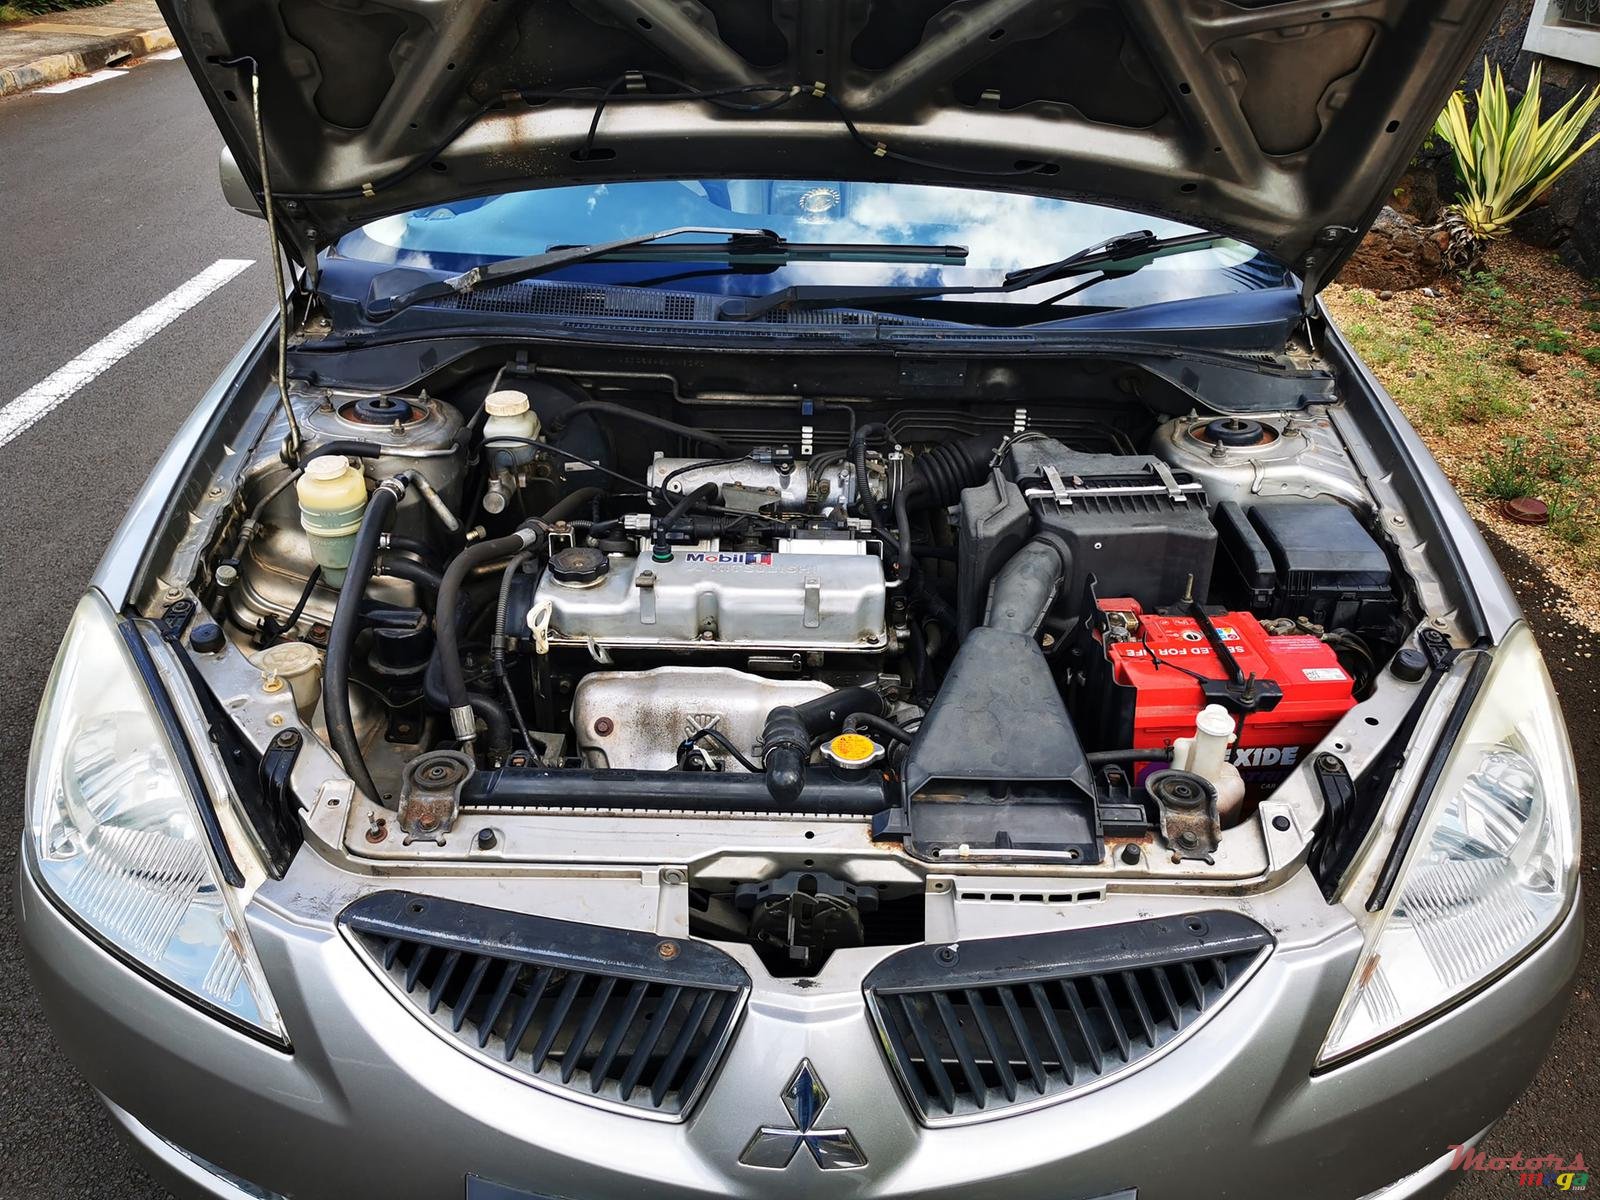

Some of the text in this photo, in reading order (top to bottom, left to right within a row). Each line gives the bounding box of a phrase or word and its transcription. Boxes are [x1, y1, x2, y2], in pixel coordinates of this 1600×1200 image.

[686, 553, 744, 563] Mobil
[1158, 647, 1188, 656] FOR
[1190, 645, 1245, 655] SEED
